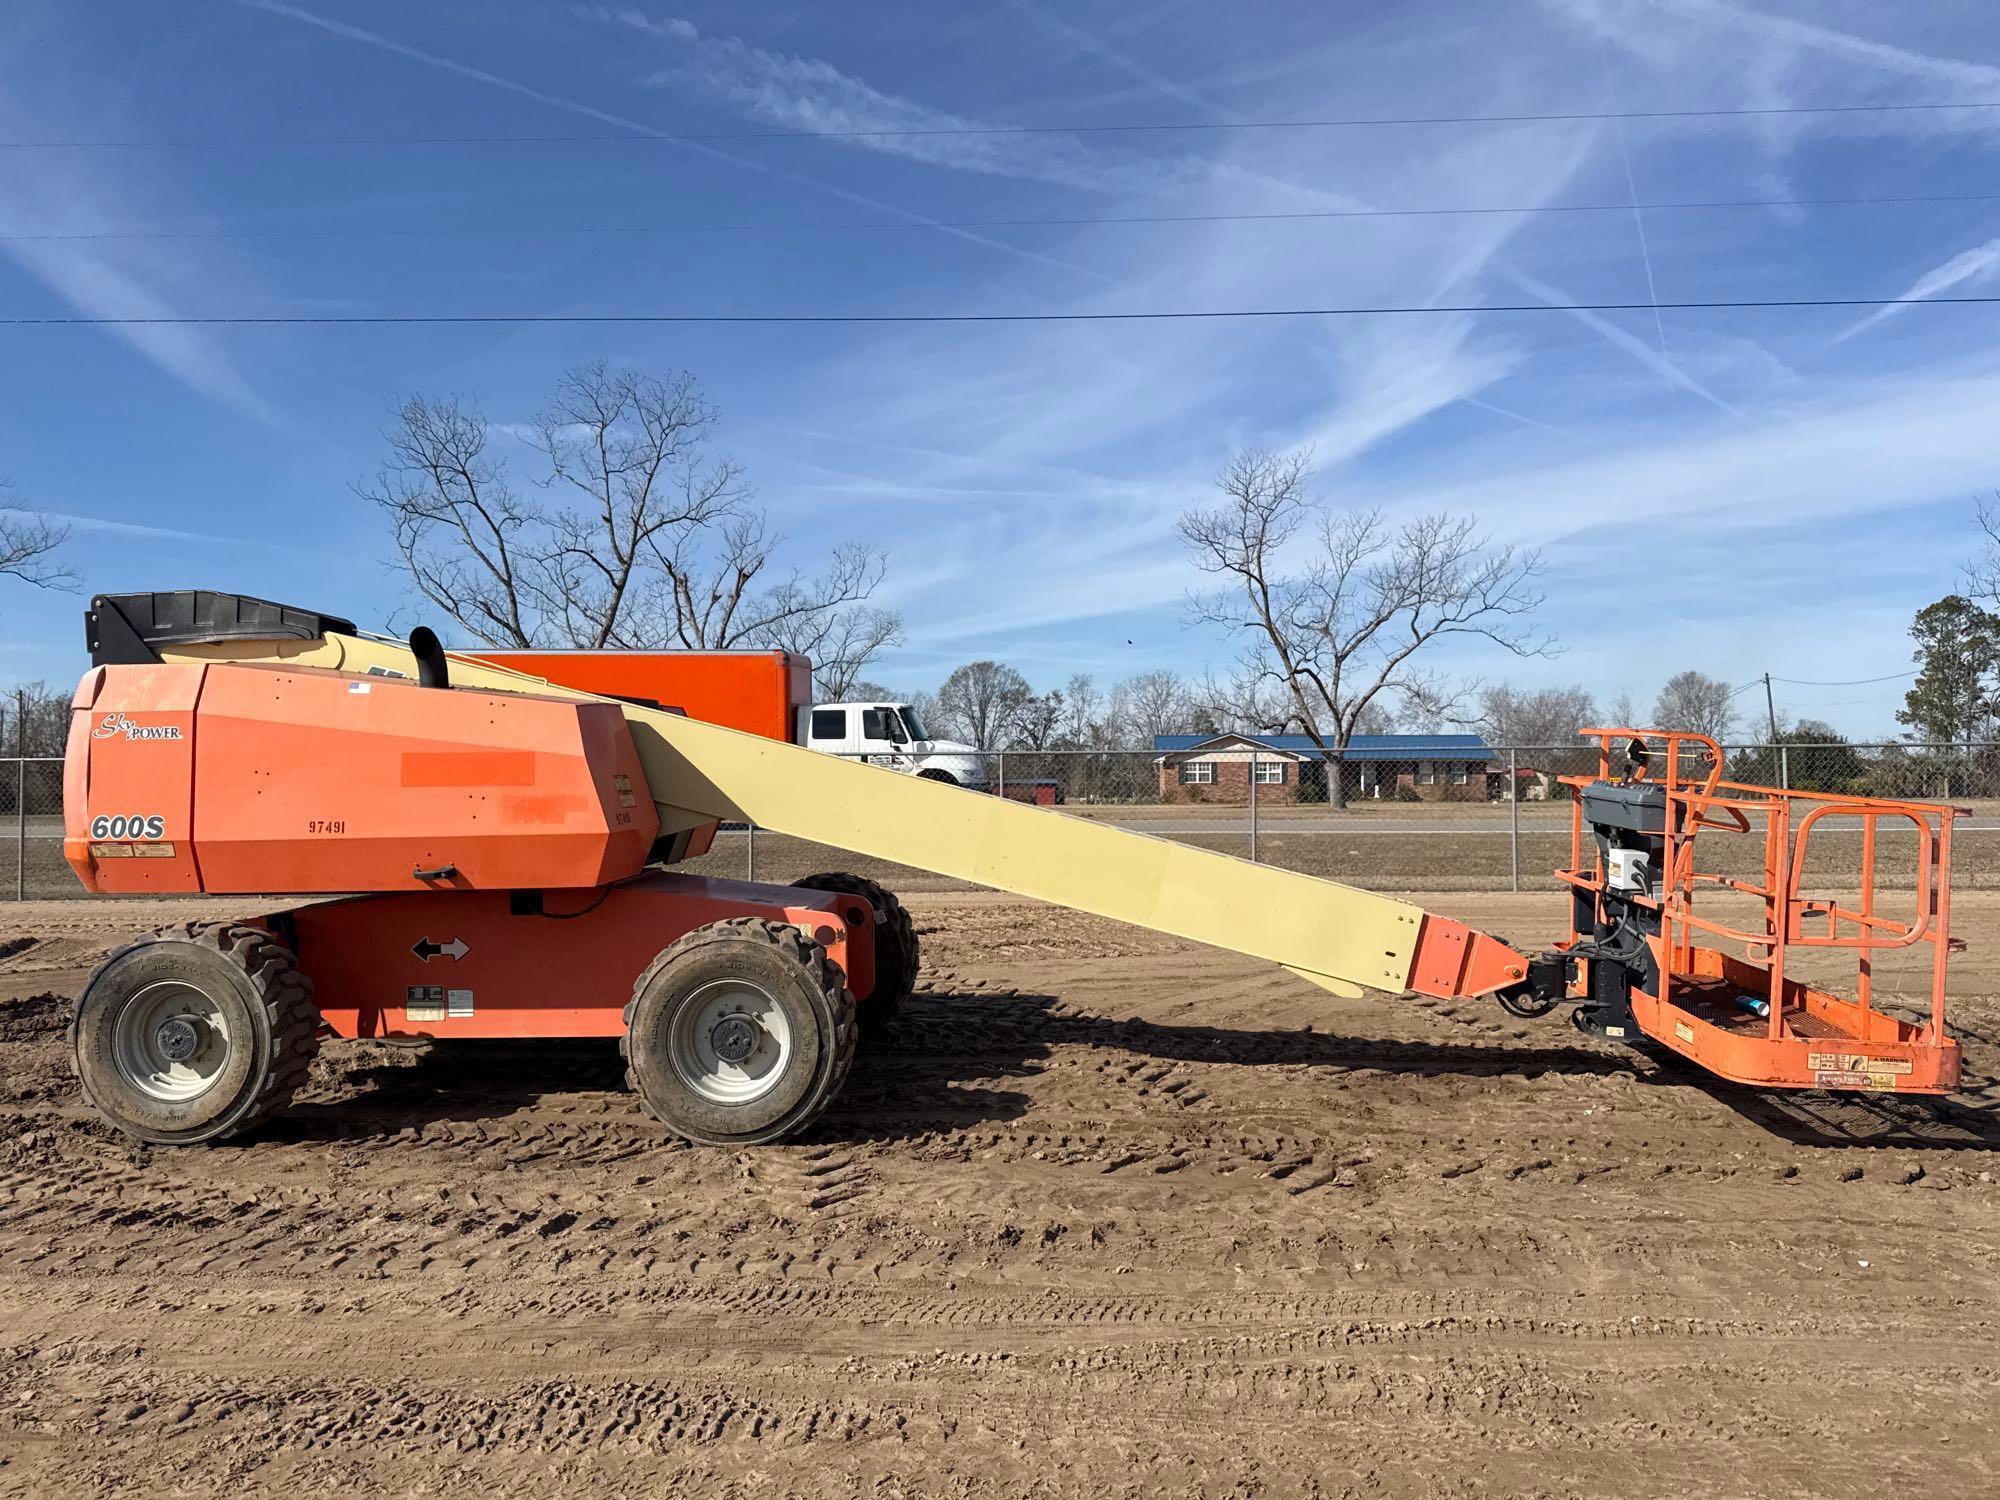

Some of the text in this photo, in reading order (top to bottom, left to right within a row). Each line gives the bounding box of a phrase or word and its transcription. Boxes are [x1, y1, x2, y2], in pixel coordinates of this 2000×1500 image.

[92, 713, 179, 740] Sky POWER
[91, 815, 164, 839] 600S
[309, 821, 345, 834] 97491
